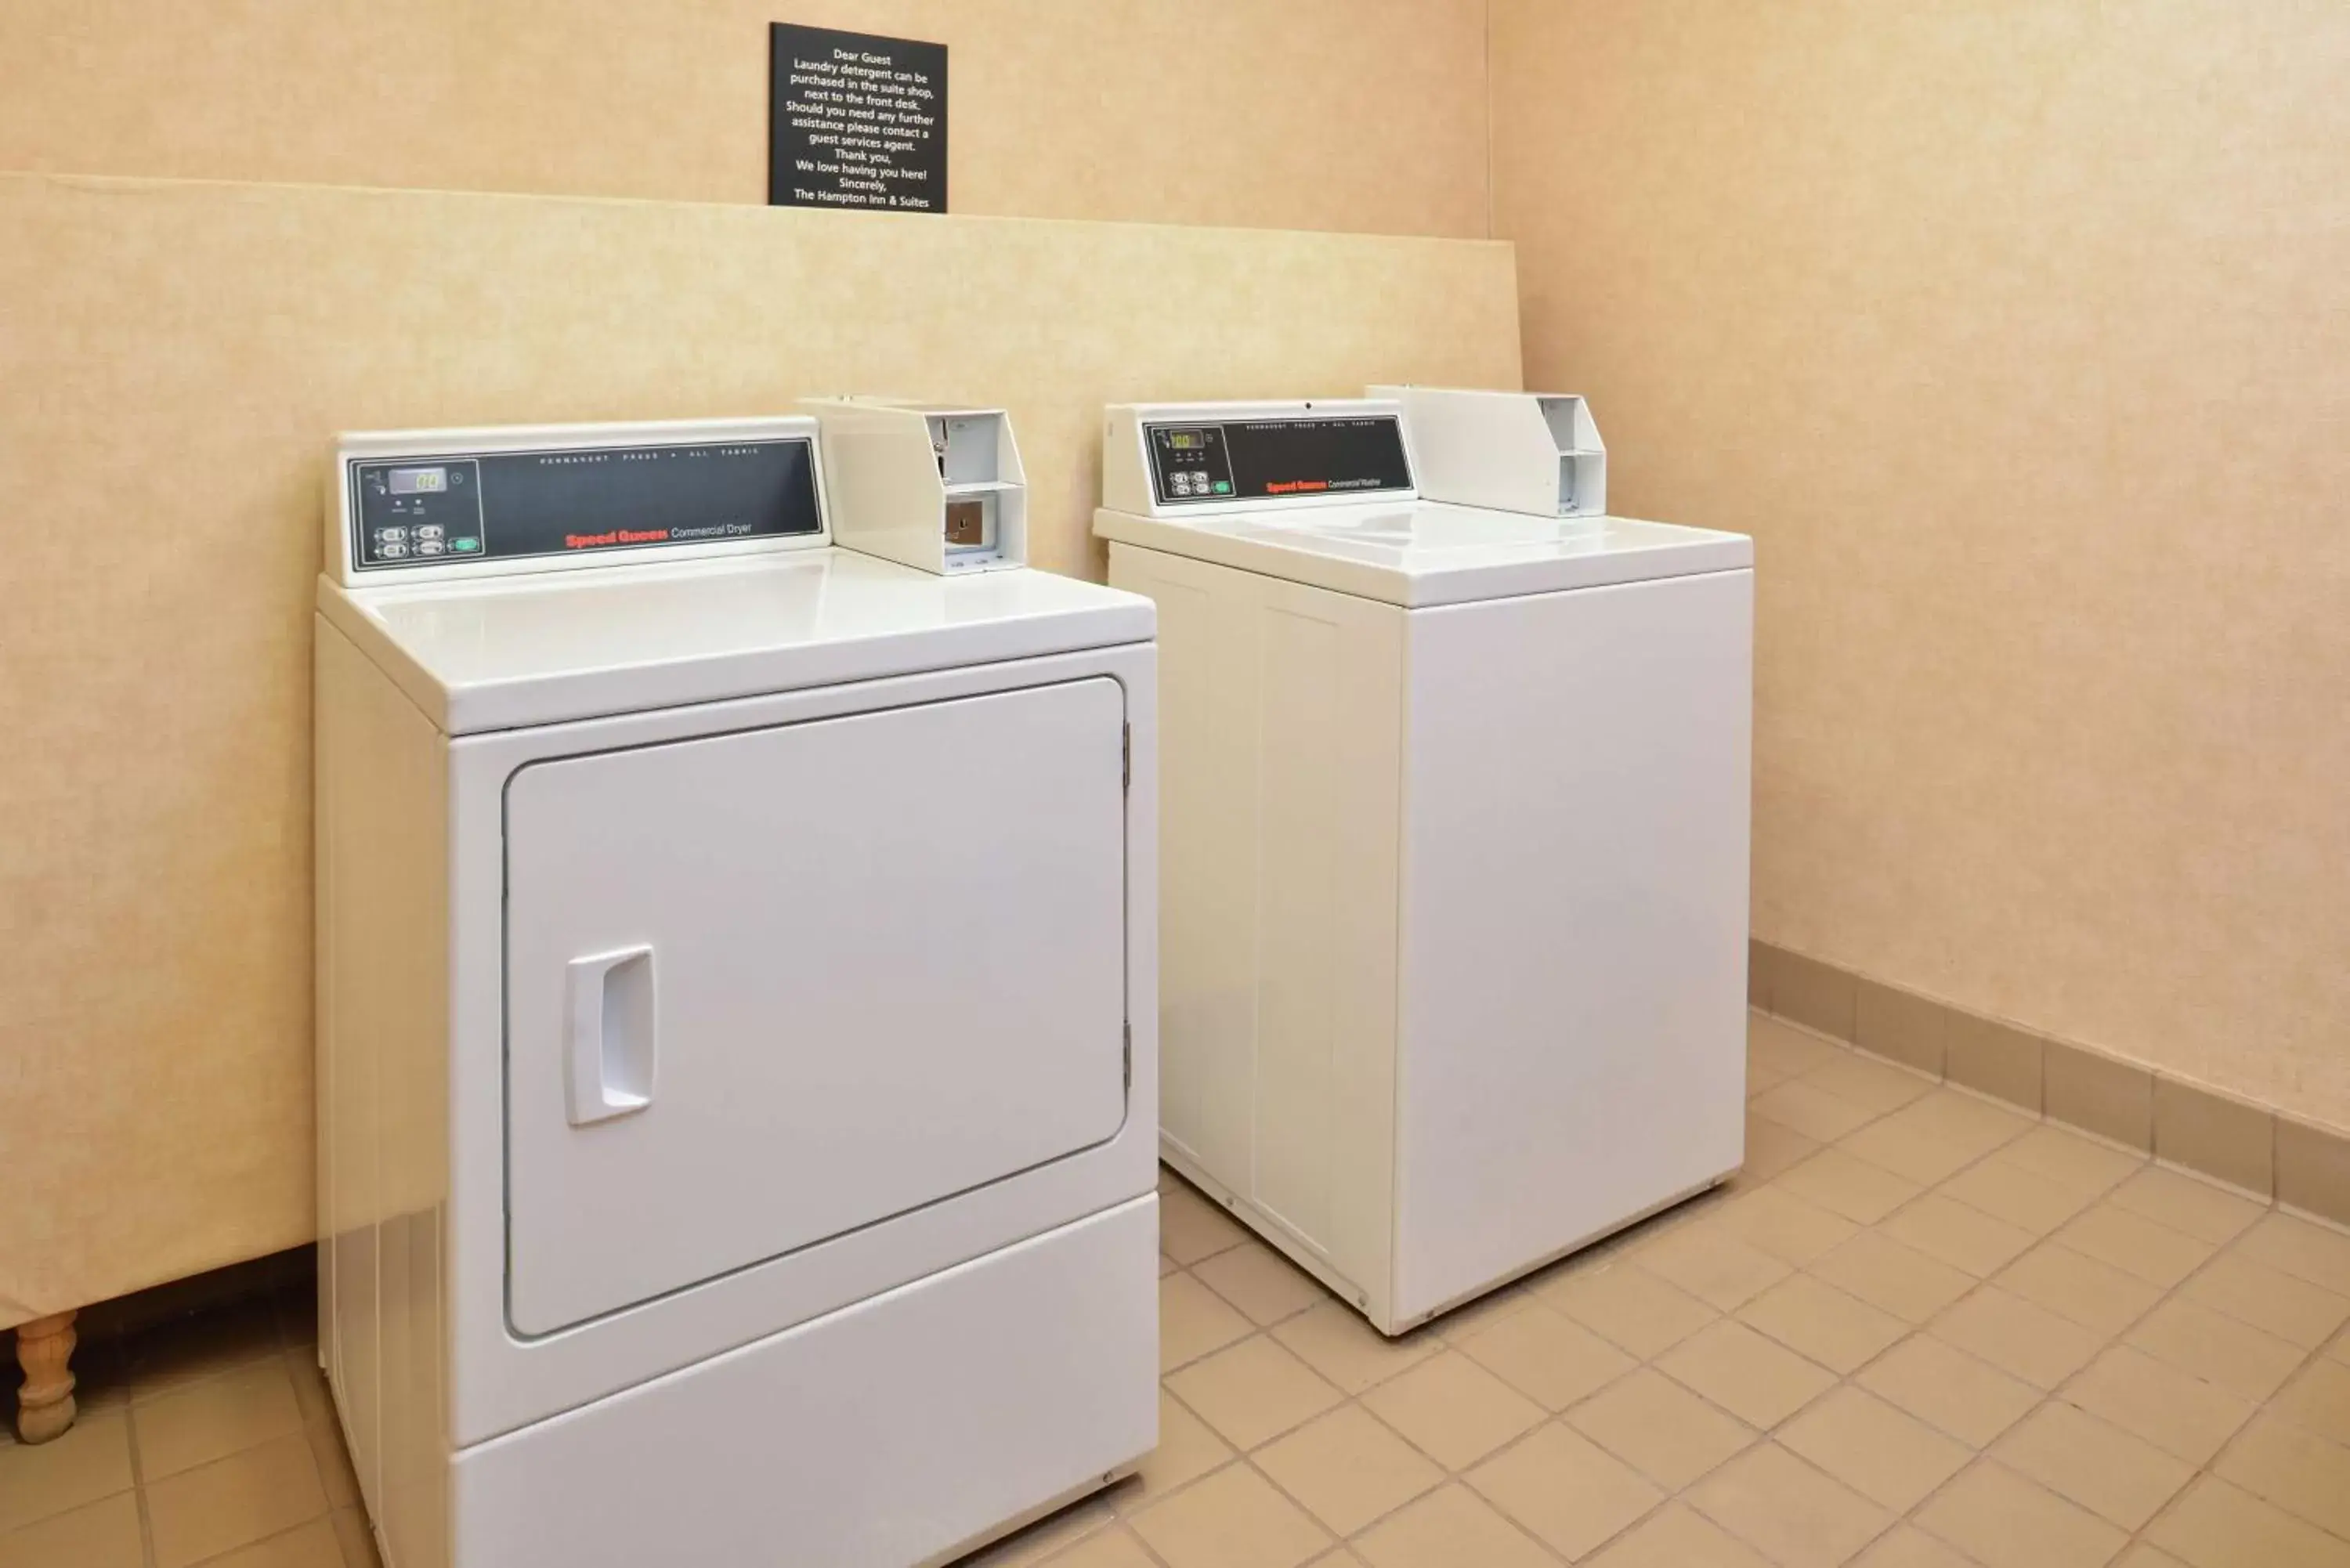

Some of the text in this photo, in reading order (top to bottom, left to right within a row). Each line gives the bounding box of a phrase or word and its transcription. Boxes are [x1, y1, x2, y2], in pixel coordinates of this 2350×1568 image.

[834, 49, 891, 65] Dear Guest
[794, 58, 927, 83] Laundry detergent can be
[790, 74, 934, 99] purchased in the suite shop,
[804, 91, 921, 110] next to the front desk.
[786, 101, 934, 125] Should you need any further
[792, 117, 844, 131] assistance
[848, 122, 879, 134] please
[883, 126, 920, 138] contact
[809, 134, 916, 151] guest services agent.
[835, 149, 891, 164] Thank you,
[796, 161, 927, 179] We love having you here!
[840, 178, 887, 193] Sincerely,
[794, 189, 929, 208] The Hampton Inn & Suites
[1266, 481, 1296, 493] Speed
[1296, 479, 1328, 490] Queen
[566, 522, 751, 547] Speed Queen Commercial Dryer
